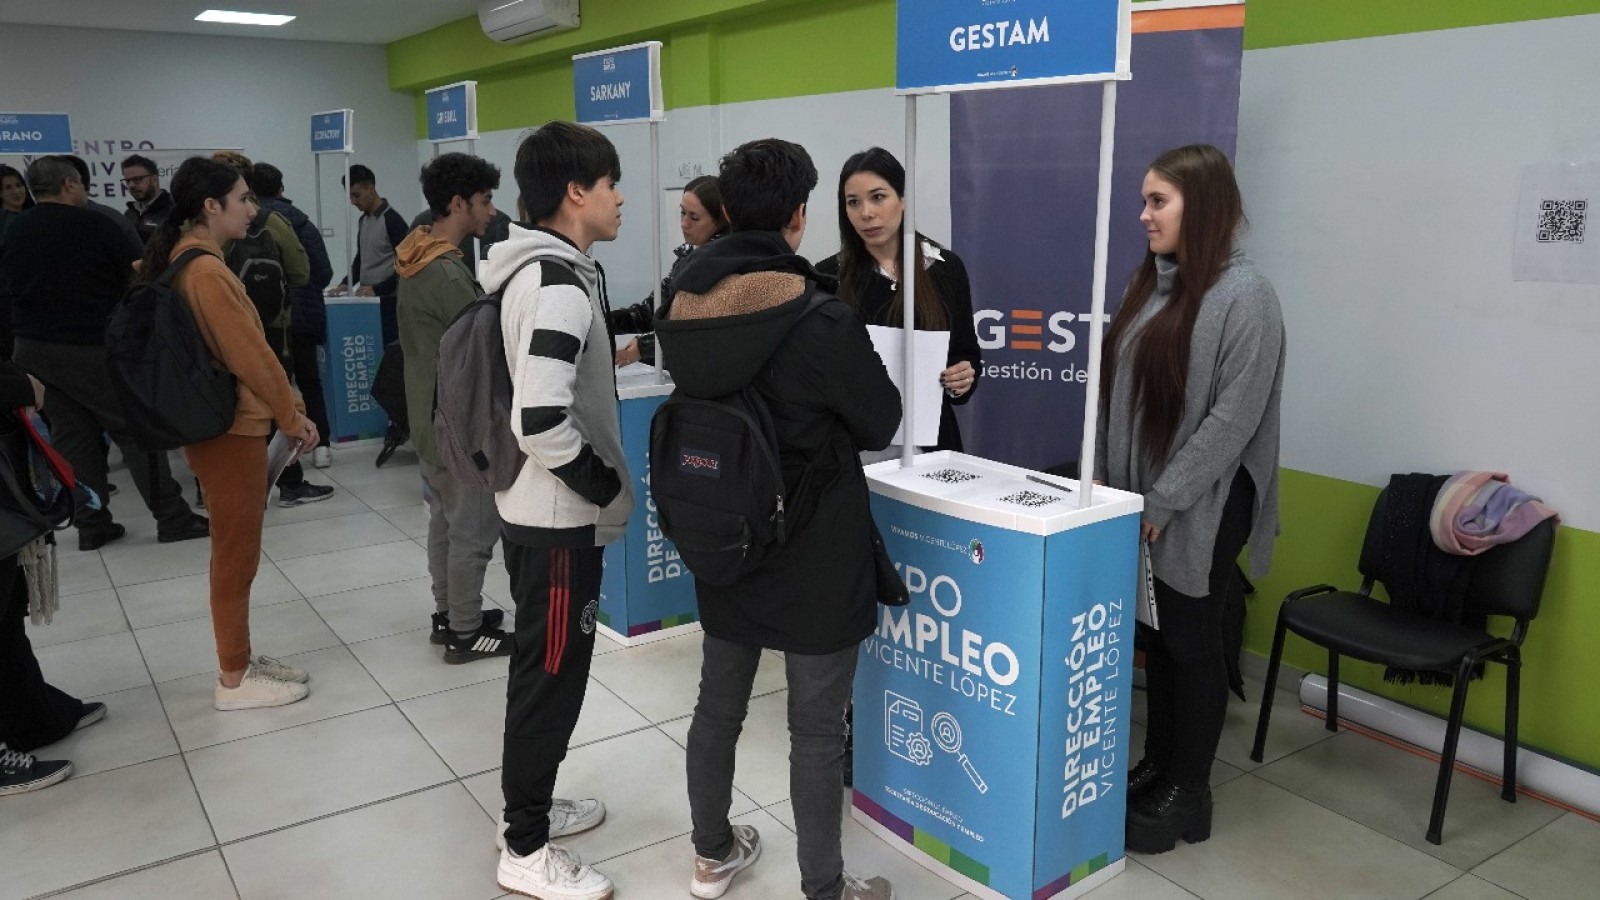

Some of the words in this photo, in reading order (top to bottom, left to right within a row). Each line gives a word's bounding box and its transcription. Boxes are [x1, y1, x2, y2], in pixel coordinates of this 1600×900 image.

[950, 16, 1050, 51] GESTAM
[590, 81, 631, 102] SARKANY
[0, 131, 42, 141] RANO
[341, 336, 359, 413] DIRECCIÓN
[354, 334, 369, 391] EMPLEO
[1060, 363, 1088, 383] de
[360, 394, 370, 412] DE
[875, 601, 1020, 687] MPLEO
[1105, 597, 1123, 681] LÓPEZ
[864, 639, 944, 686] VICENTE
[950, 671, 1018, 717] LÓPEZ
[1083, 602, 1107, 750] EMPLEO
[1061, 611, 1087, 820] DIRECCIÓN
[1101, 686, 1119, 798] VICENTE
[1078, 757, 1099, 808] DE
